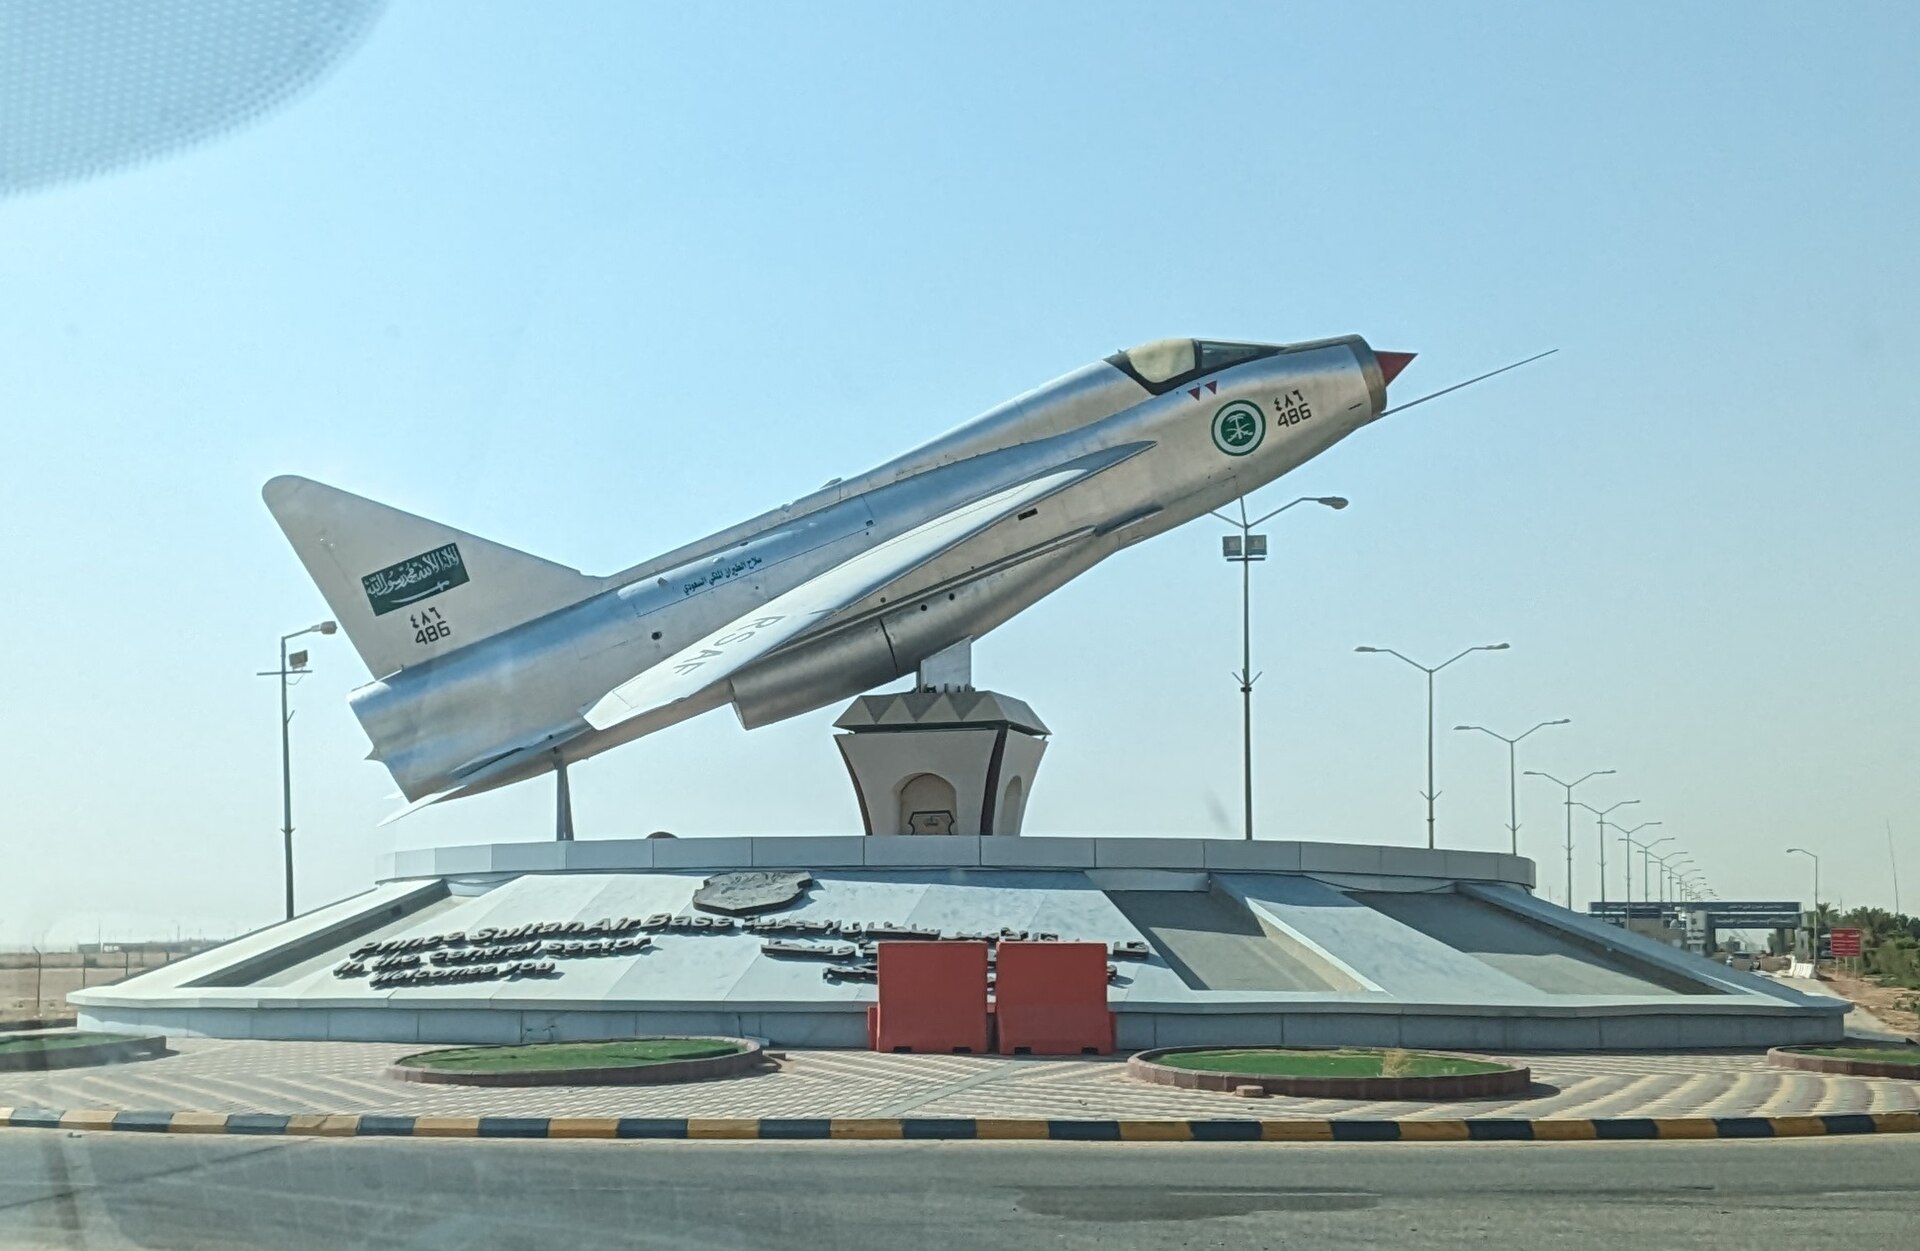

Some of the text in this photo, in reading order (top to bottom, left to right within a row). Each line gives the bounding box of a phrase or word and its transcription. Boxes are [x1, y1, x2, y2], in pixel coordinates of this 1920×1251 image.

[1274, 389, 1304, 411] ٤٨٦
[1277, 403, 1312, 427] 486
[410, 607, 441, 629] ٤٨٦
[415, 620, 451, 645] 486
[349, 912, 735, 959] Prince Sultan Air Base
[429, 940, 541, 964] central
[546, 936, 651, 955] sector
[498, 960, 556, 979] you
